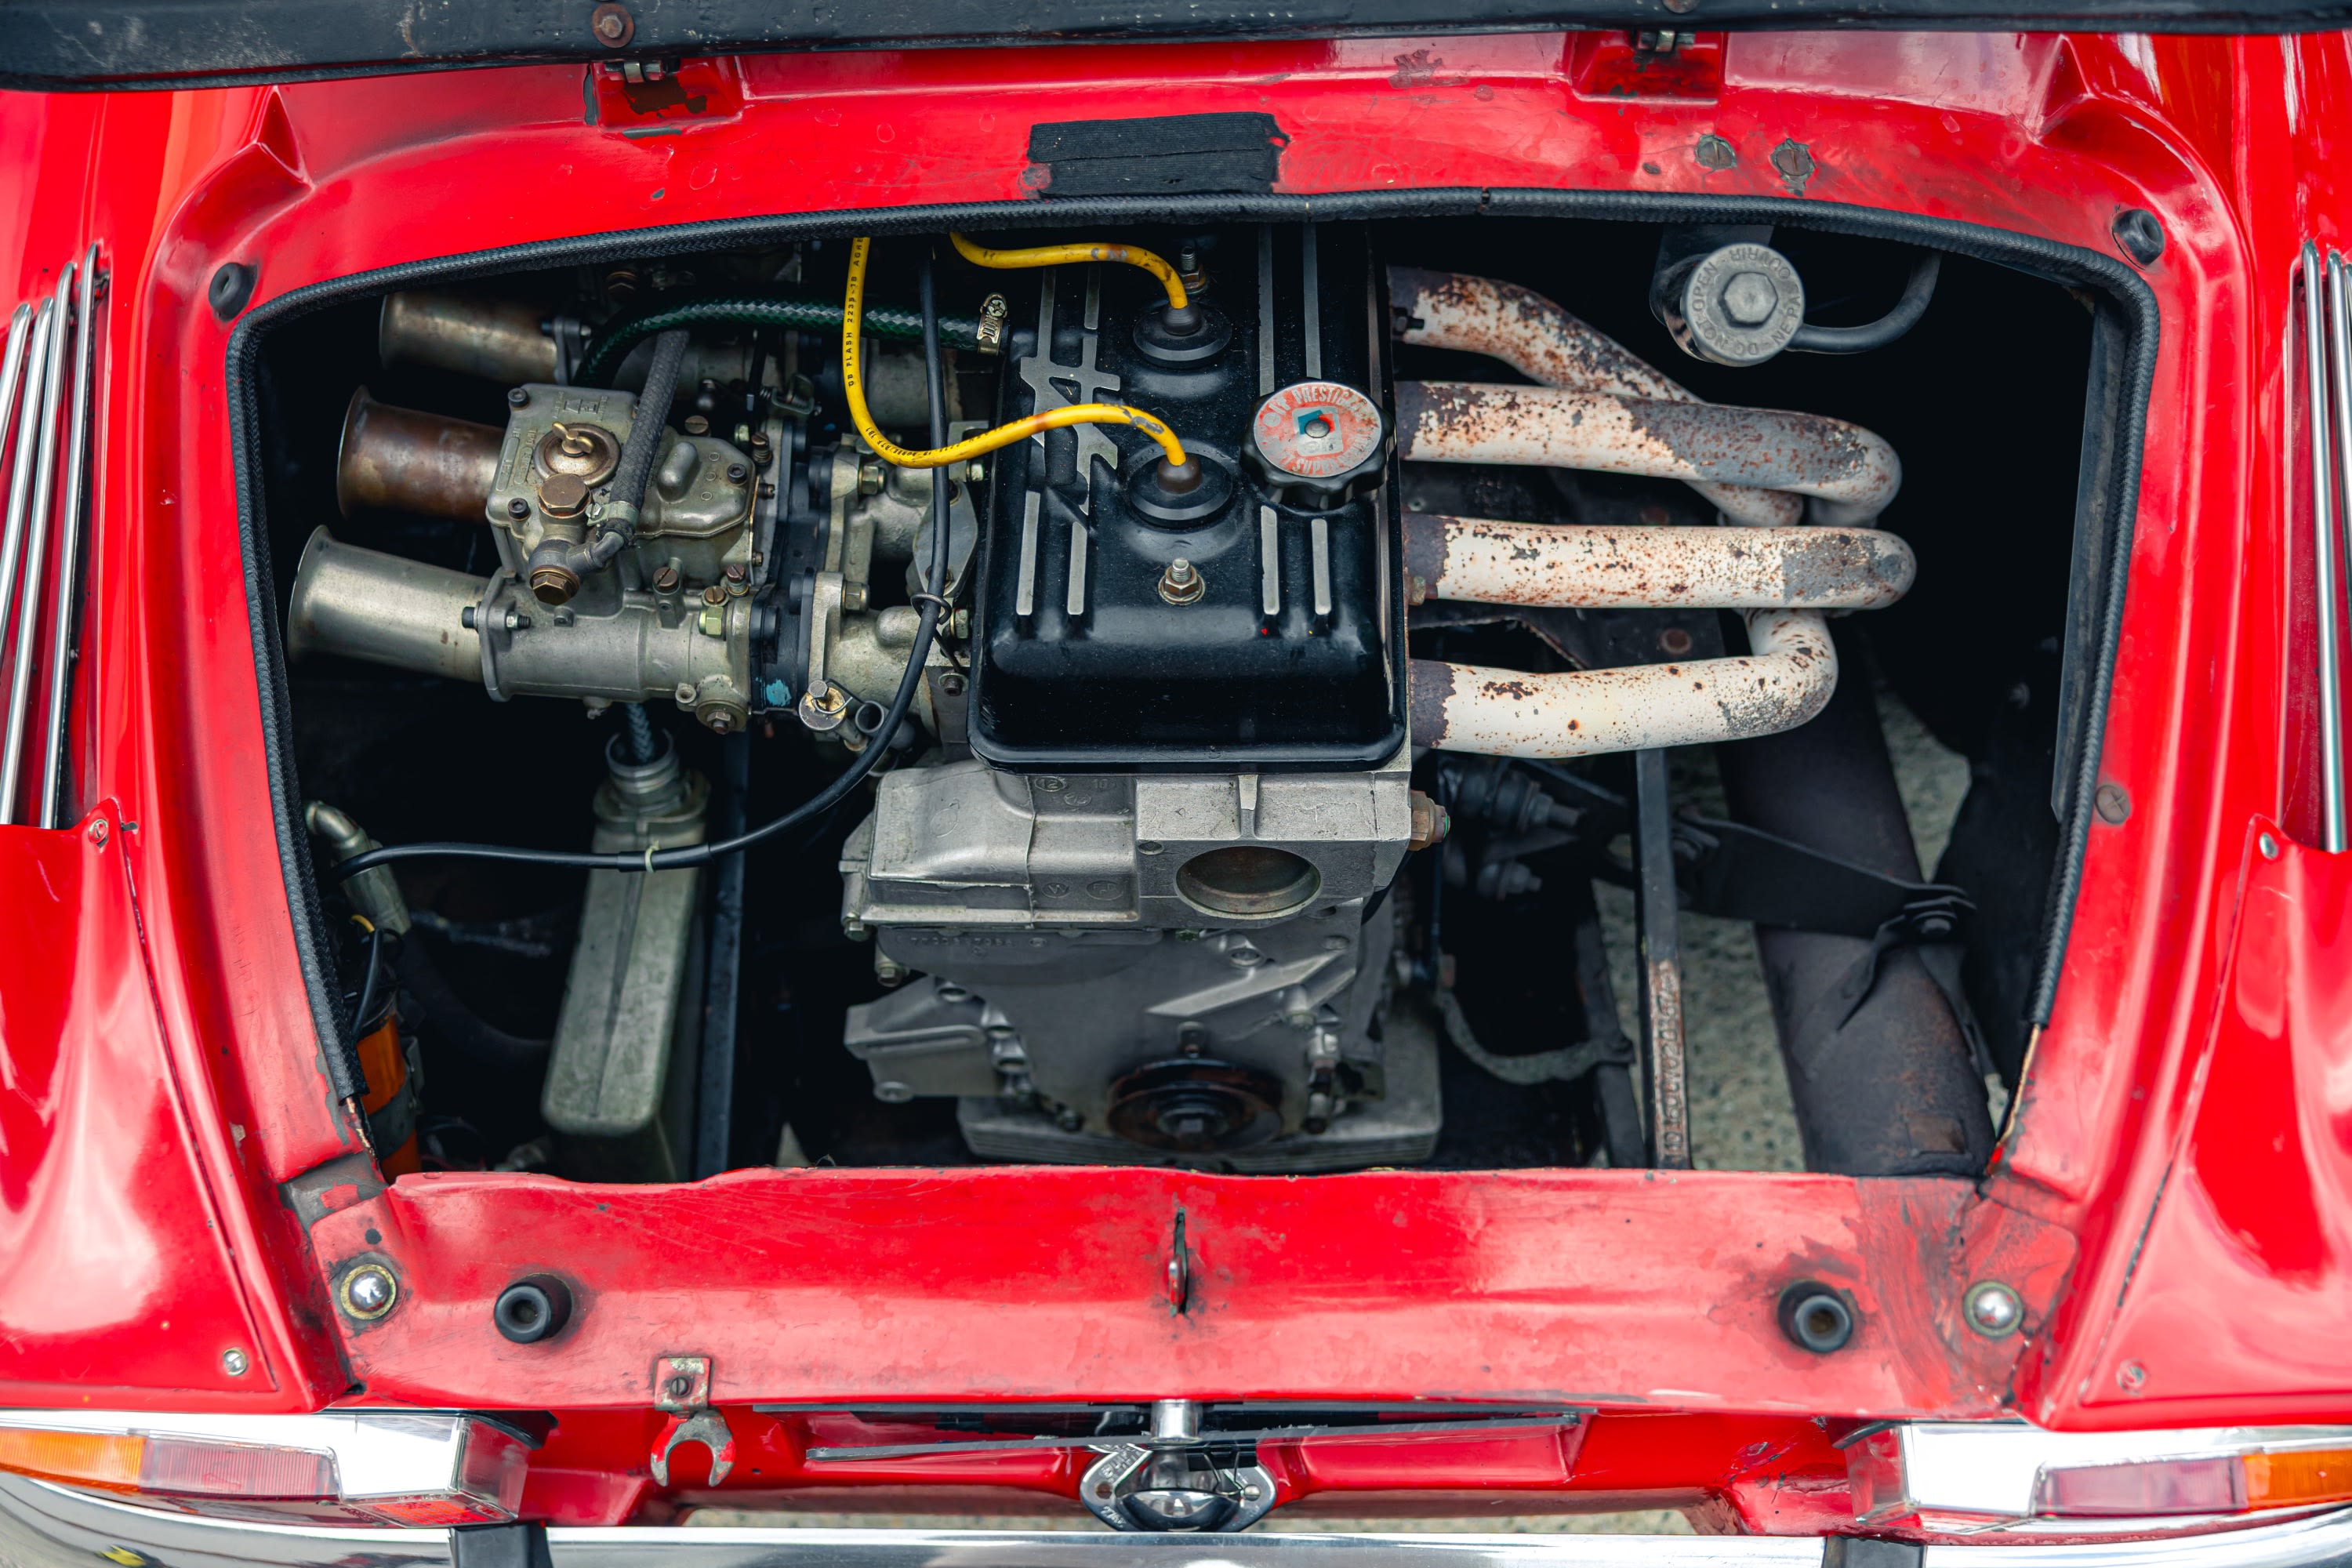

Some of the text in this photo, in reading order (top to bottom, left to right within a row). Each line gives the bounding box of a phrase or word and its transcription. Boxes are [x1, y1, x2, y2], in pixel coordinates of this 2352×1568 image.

[1692, 262, 1759, 356] DO NOT OPEN
